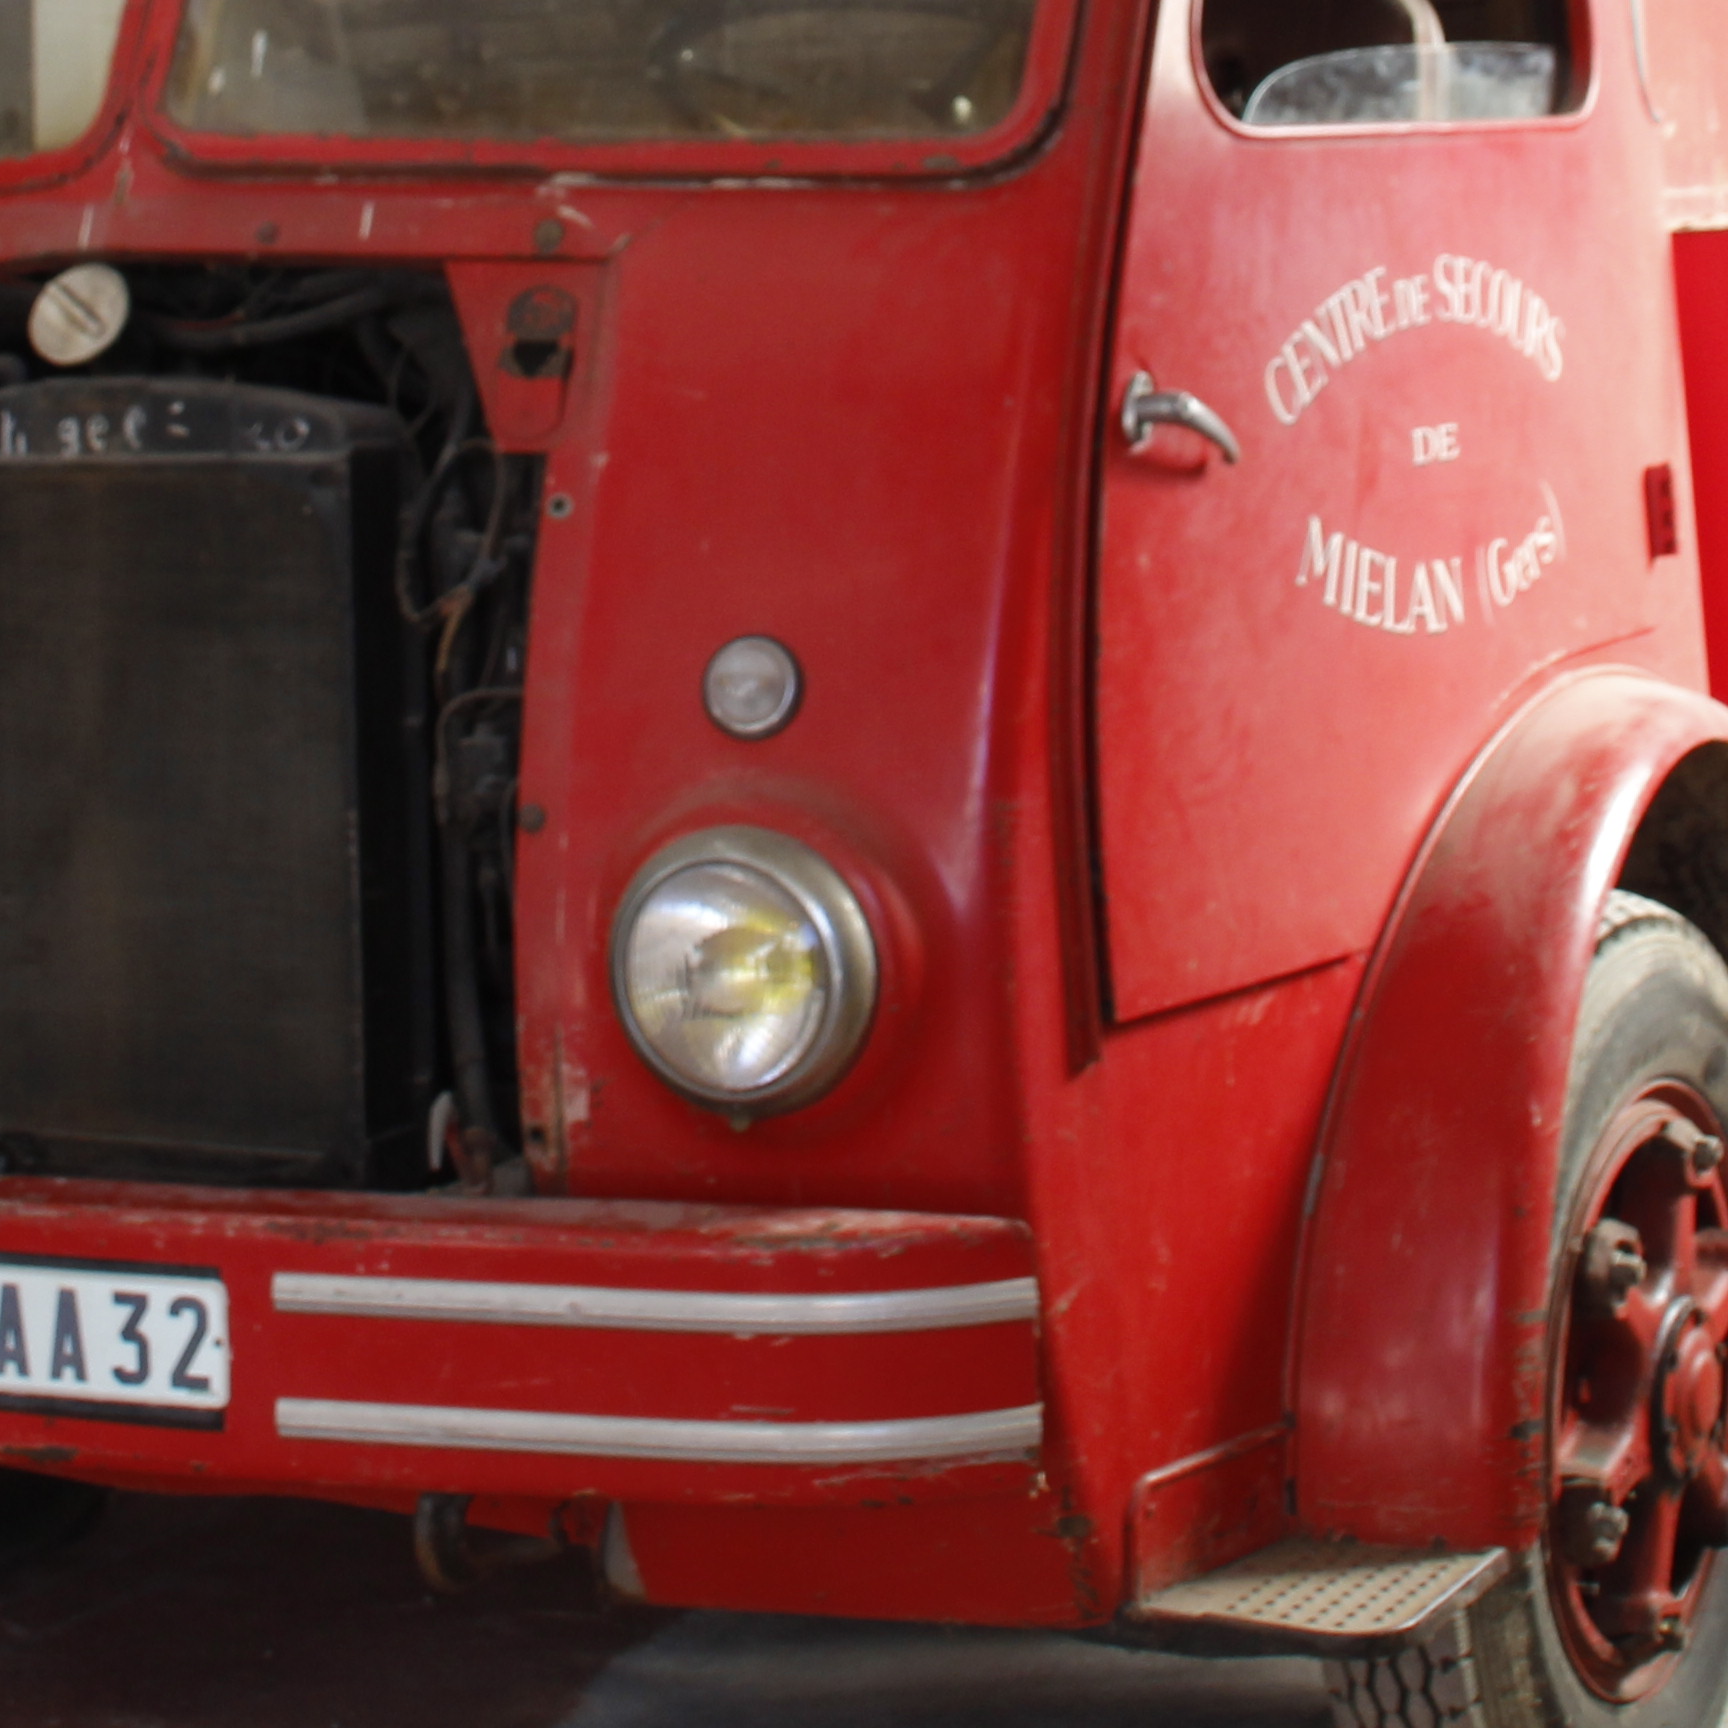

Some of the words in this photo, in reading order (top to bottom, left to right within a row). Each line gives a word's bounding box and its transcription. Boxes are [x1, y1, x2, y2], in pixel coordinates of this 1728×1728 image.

[1264, 266, 1397, 425] CENTRE
[1393, 274, 1431, 329] DE
[1433, 253, 1566, 382] SECOURS
[1410, 421, 1461, 466] DE
[1294, 514, 1466, 635] MIELAN
